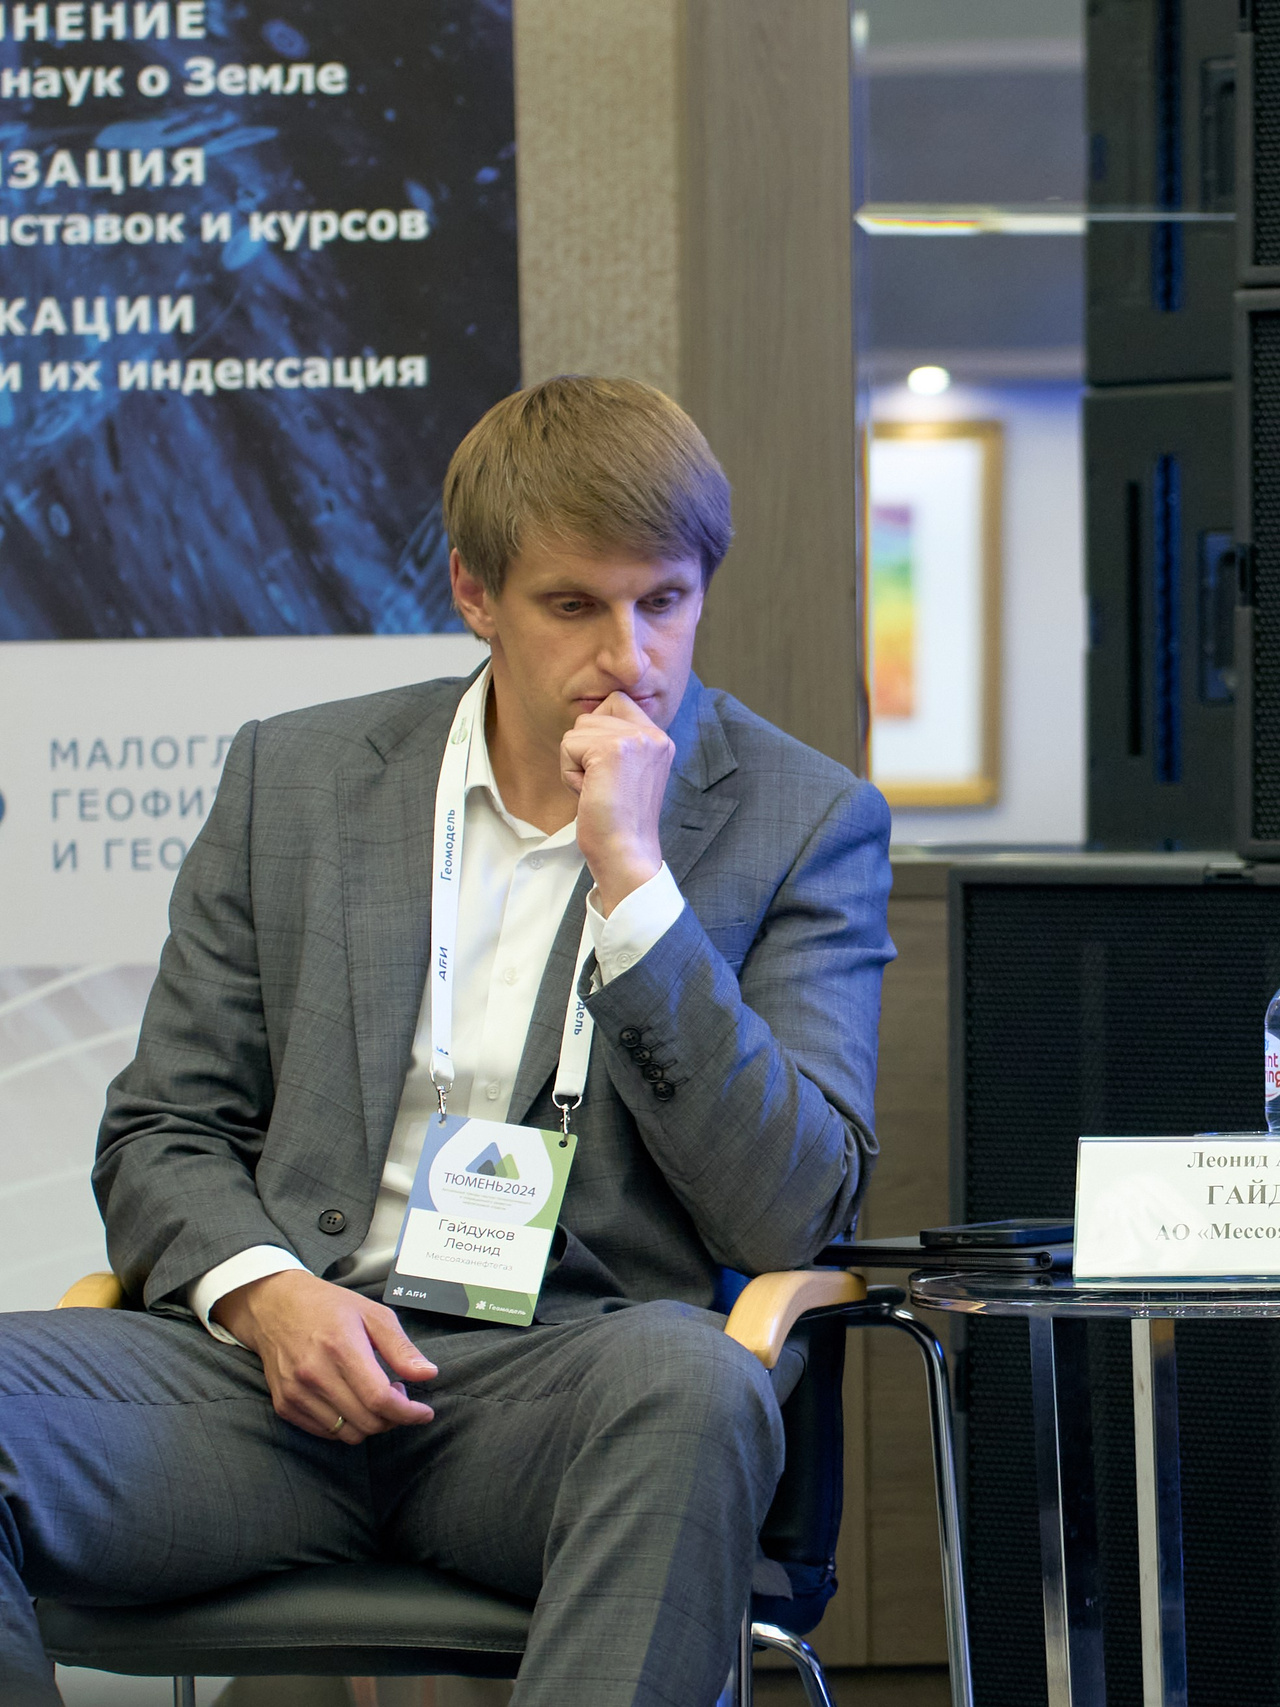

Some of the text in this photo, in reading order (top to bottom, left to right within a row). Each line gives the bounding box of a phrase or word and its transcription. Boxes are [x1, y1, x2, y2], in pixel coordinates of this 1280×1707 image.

[1, 57, 347, 107] наук о Земле
[0, 148, 206, 194] ЗАЦИЯ
[201, 212, 232, 243] и
[249, 208, 429, 249] курсов
[0, 295, 195, 342] КАЦИИ
[0, 355, 427, 393] и их индексация
[50, 786, 218, 822] ГЕОФИ
[52, 837, 187, 872] И ГЕО
[440, 809, 456, 881] Геомодель
[1187, 1151, 1268, 1170] Леонид
[443, 1172, 536, 1198] ТЮМЕНЬ2024
[438, 1218, 515, 1241] Гайдуков
[443, 1237, 501, 1257] Леонид
[1155, 1223, 1190, 1241] АО
[425, 1251, 513, 1272] Мессояханефтегаз
